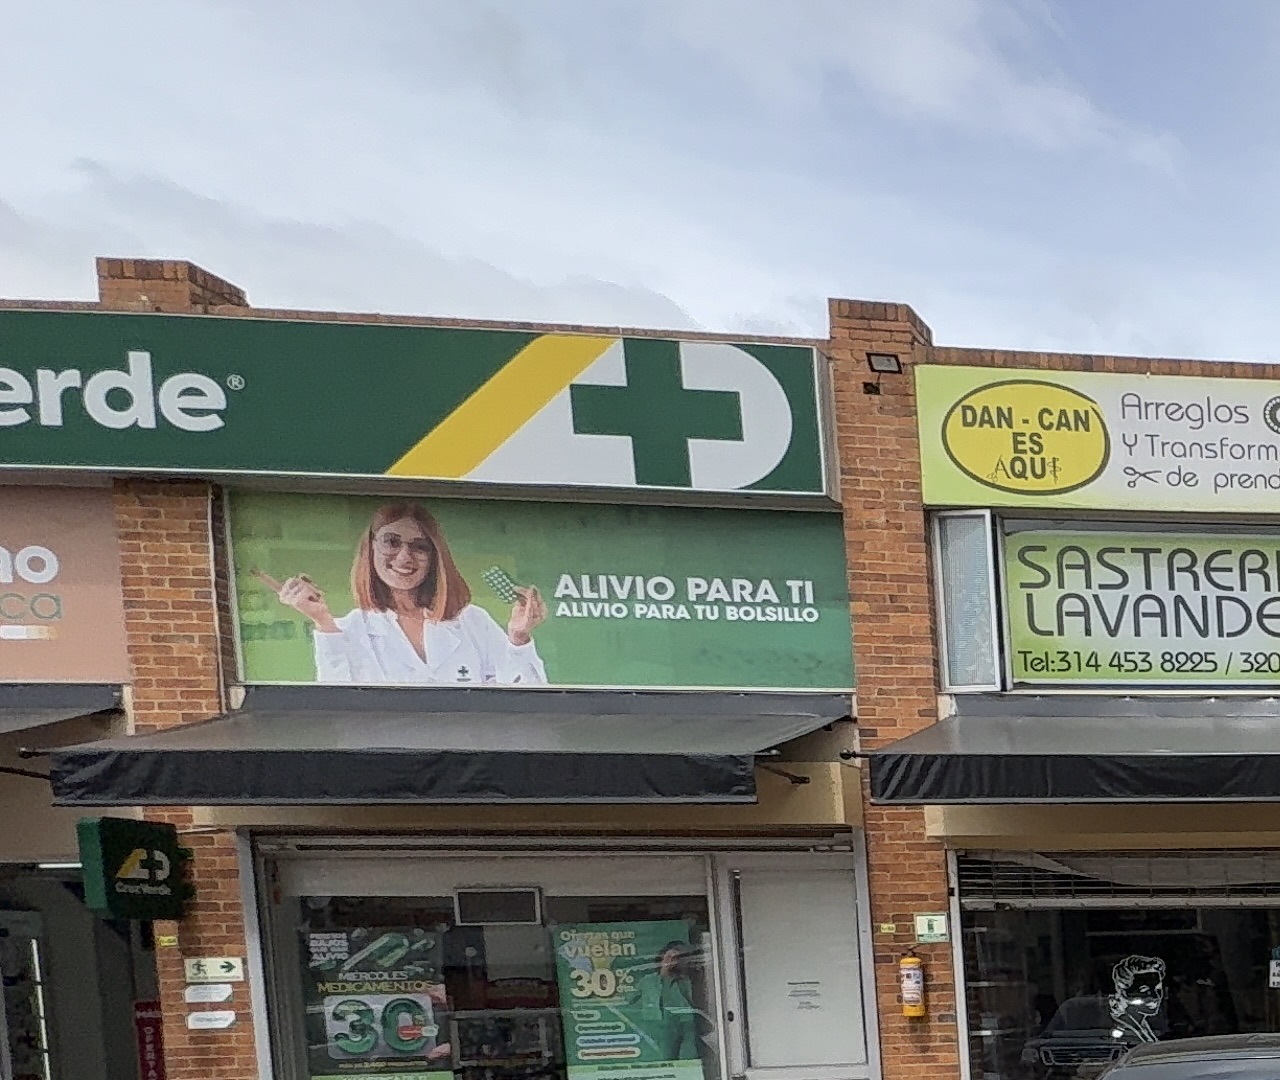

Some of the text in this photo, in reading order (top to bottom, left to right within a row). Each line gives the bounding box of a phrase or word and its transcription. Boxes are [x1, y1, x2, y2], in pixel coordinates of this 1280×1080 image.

[961, 405, 1091, 432] DAN CAN
[1121, 392, 1250, 430] Arreglos
[1012, 432, 1044, 455] ES
[1122, 433, 1138, 456] Y
[1166, 465, 1199, 488] de
[554, 574, 814, 604] ALIVIO PARA TI
[556, 602, 819, 622] ALIVIO PARA TU BOLSILLO
[1109, 651, 1152, 674] 453
[1161, 651, 1218, 674] 8225
[565, 940, 636, 957] vuelan
[318, 981, 433, 993] MEDICAMENTOS
[570, 968, 616, 998] 30
